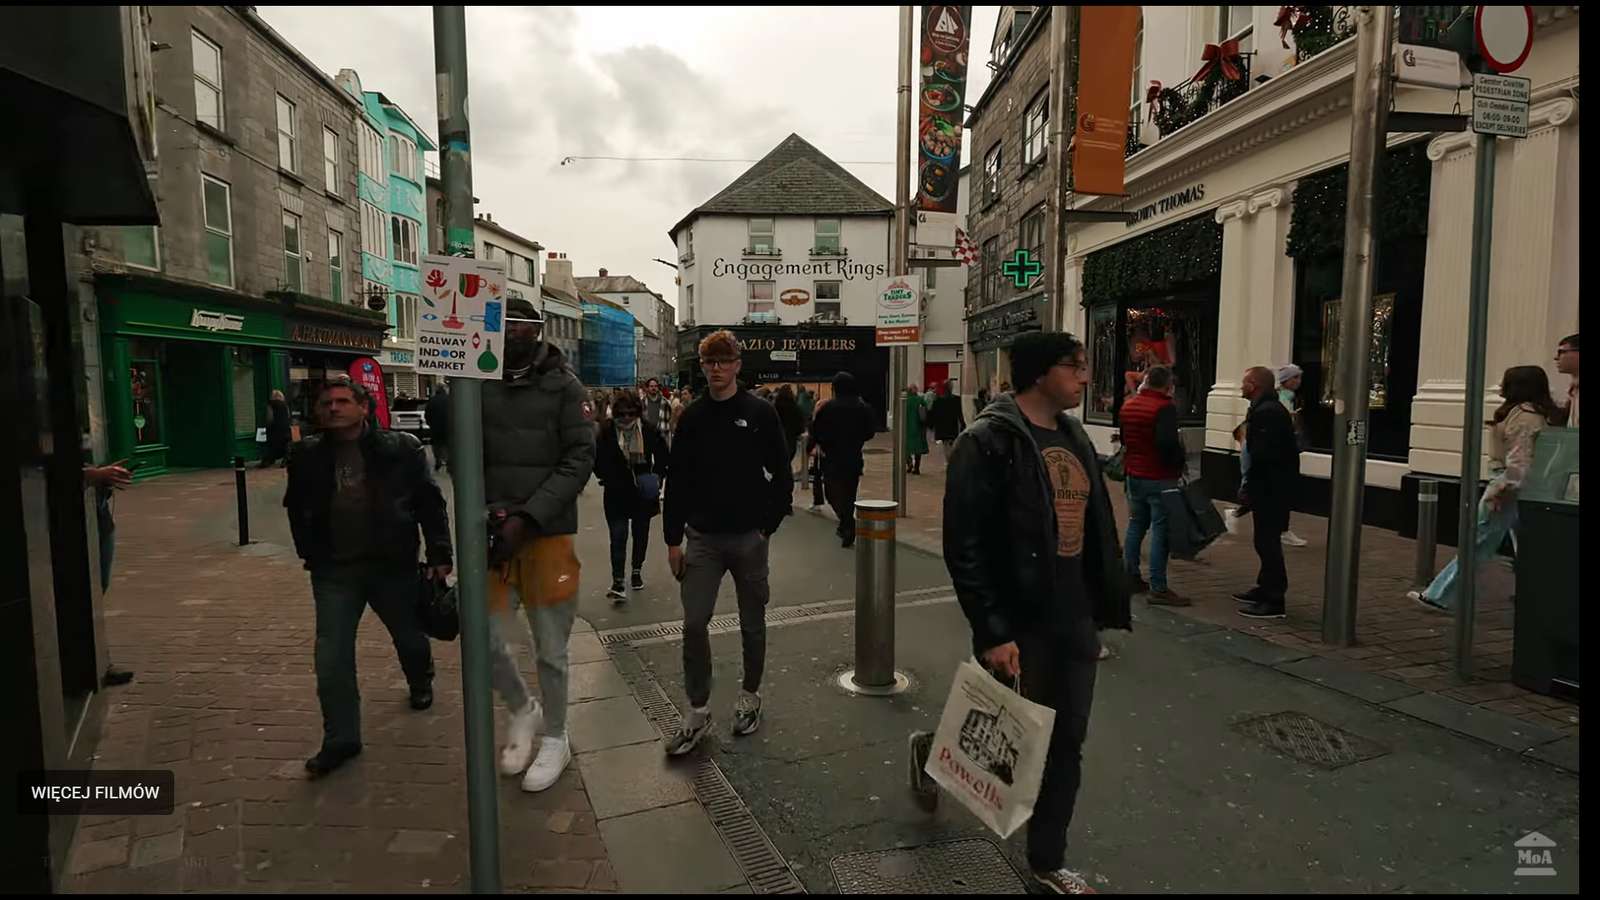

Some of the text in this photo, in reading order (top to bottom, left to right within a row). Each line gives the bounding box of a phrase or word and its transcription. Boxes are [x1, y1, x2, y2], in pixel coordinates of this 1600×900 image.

[1476, 85, 1528, 99] PEDESTRIAN ZONE
[1497, 123, 1525, 133] DELIVERIES
[1158, 184, 1205, 214] THOMAS
[713, 258, 884, 280] Engagement Rings
[420, 336, 467, 347] GALWAY
[782, 338, 857, 351] JEWELLERS
[419, 347, 466, 360] INDOOR
[418, 359, 465, 371] MARKET
[939, 746, 1004, 811] Powells
